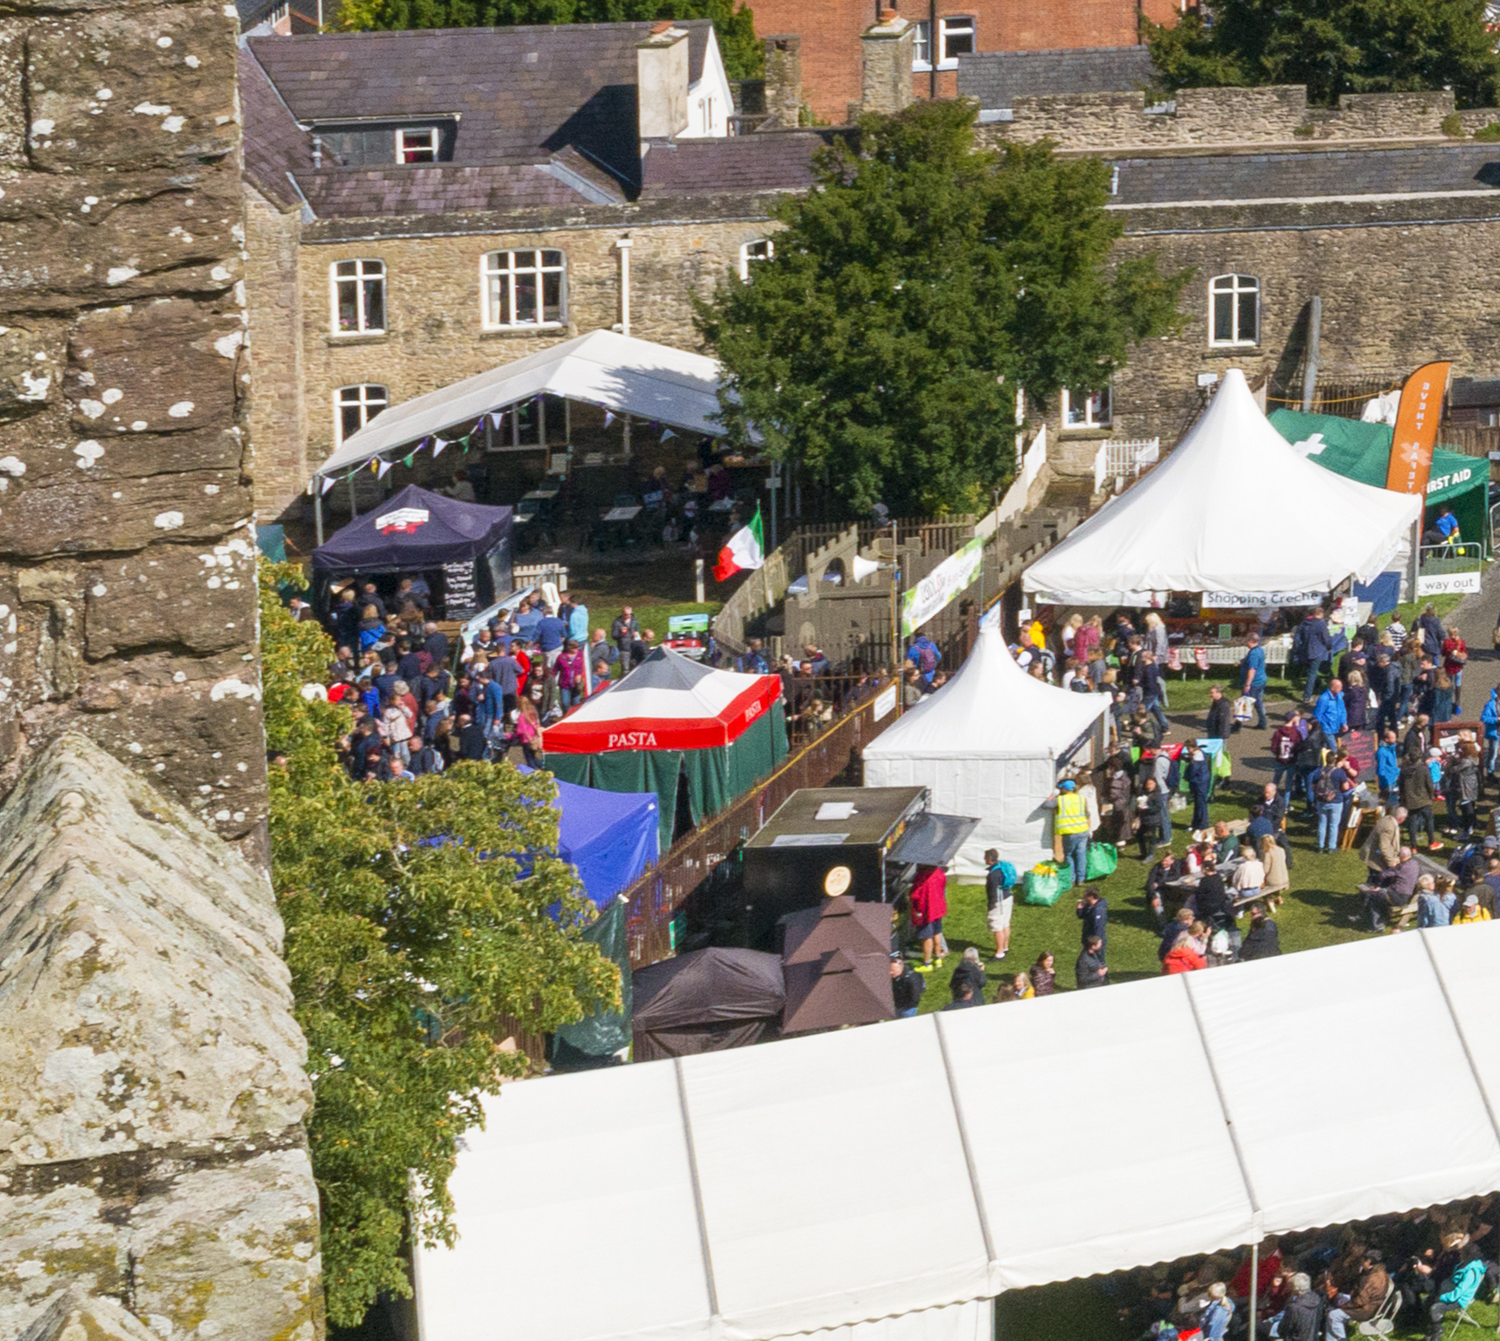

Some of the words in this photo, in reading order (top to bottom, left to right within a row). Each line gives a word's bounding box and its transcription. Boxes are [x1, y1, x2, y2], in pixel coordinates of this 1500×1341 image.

[1451, 468, 1472, 485] AID
[1424, 579, 1451, 592] way
[1453, 577, 1474, 589] out
[1207, 591, 1267, 607] Shopping
[607, 731, 658, 748] PASTA
